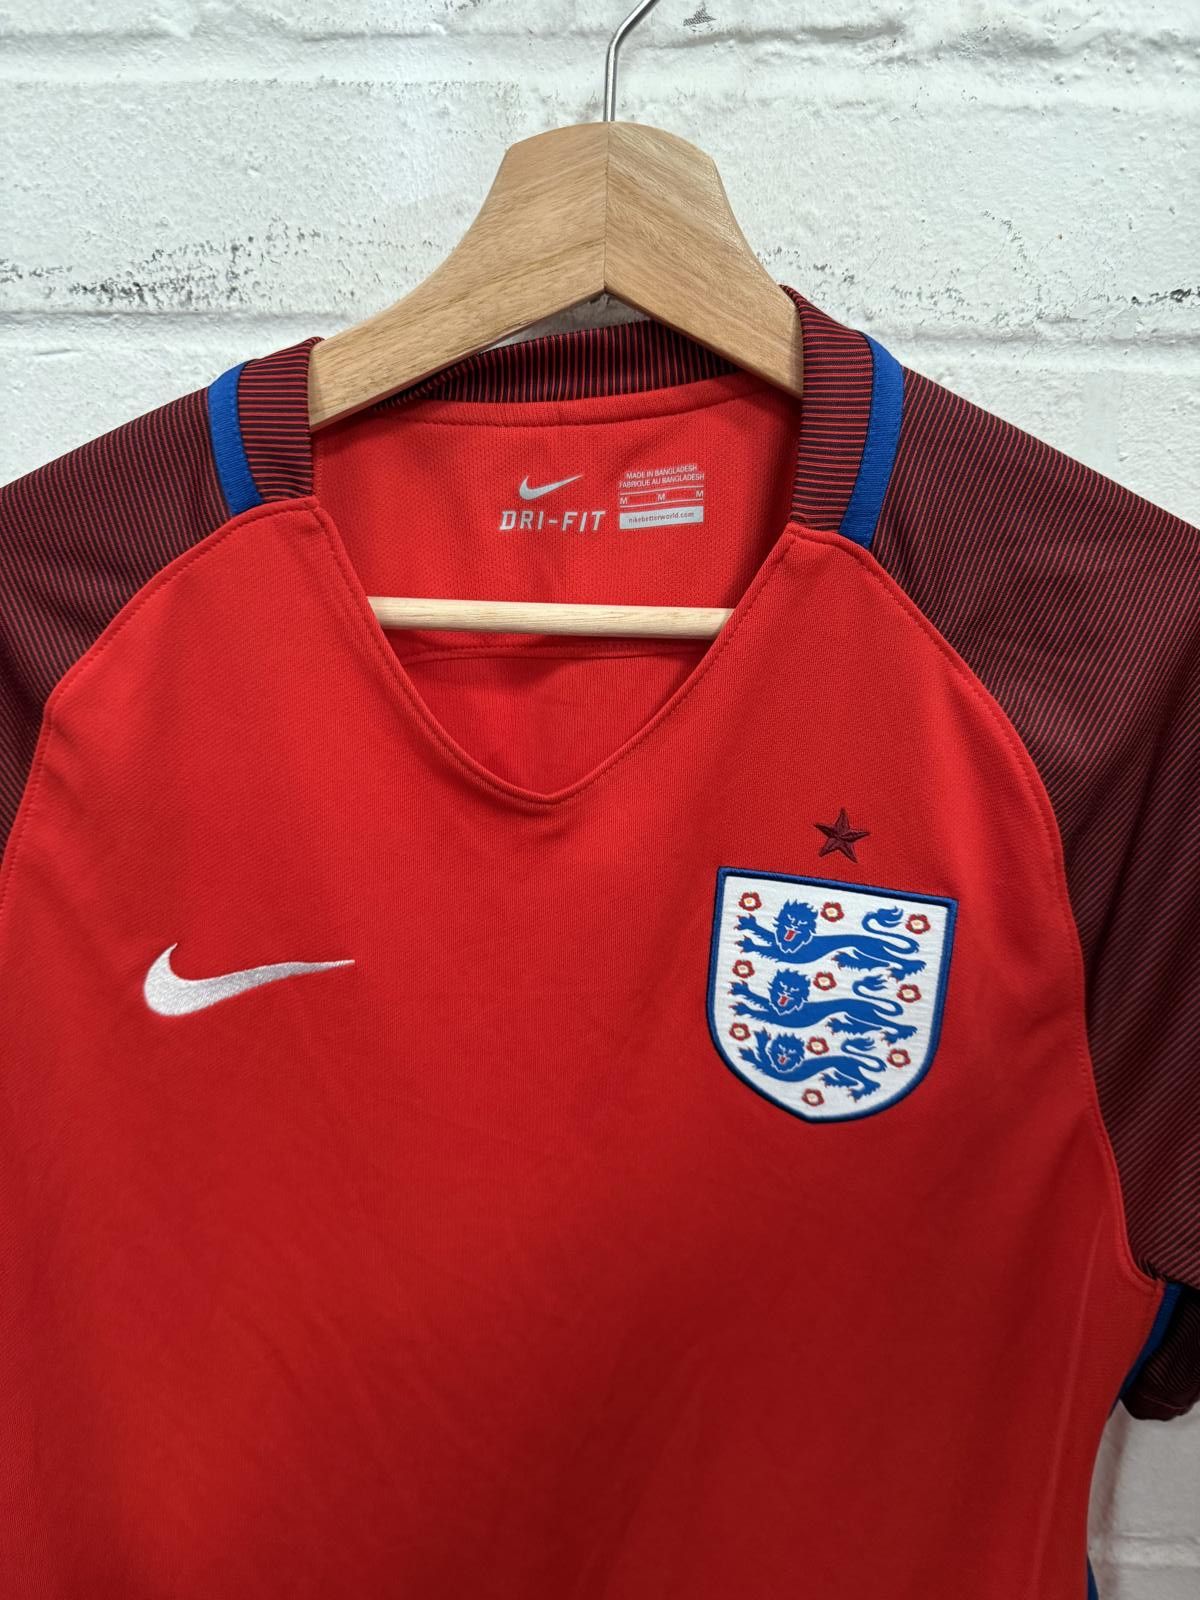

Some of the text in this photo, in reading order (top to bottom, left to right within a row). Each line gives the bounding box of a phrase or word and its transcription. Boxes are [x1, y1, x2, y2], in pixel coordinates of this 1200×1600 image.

[626, 464, 697, 480] MADE IN BANGLADESH
[652, 477, 661, 485] AU
[662, 473, 704, 484] BANGLADESH
[620, 490, 704, 505] M M M
[499, 510, 606, 532] DRI-FIT
[628, 512, 695, 524] nikebetterworld.com
